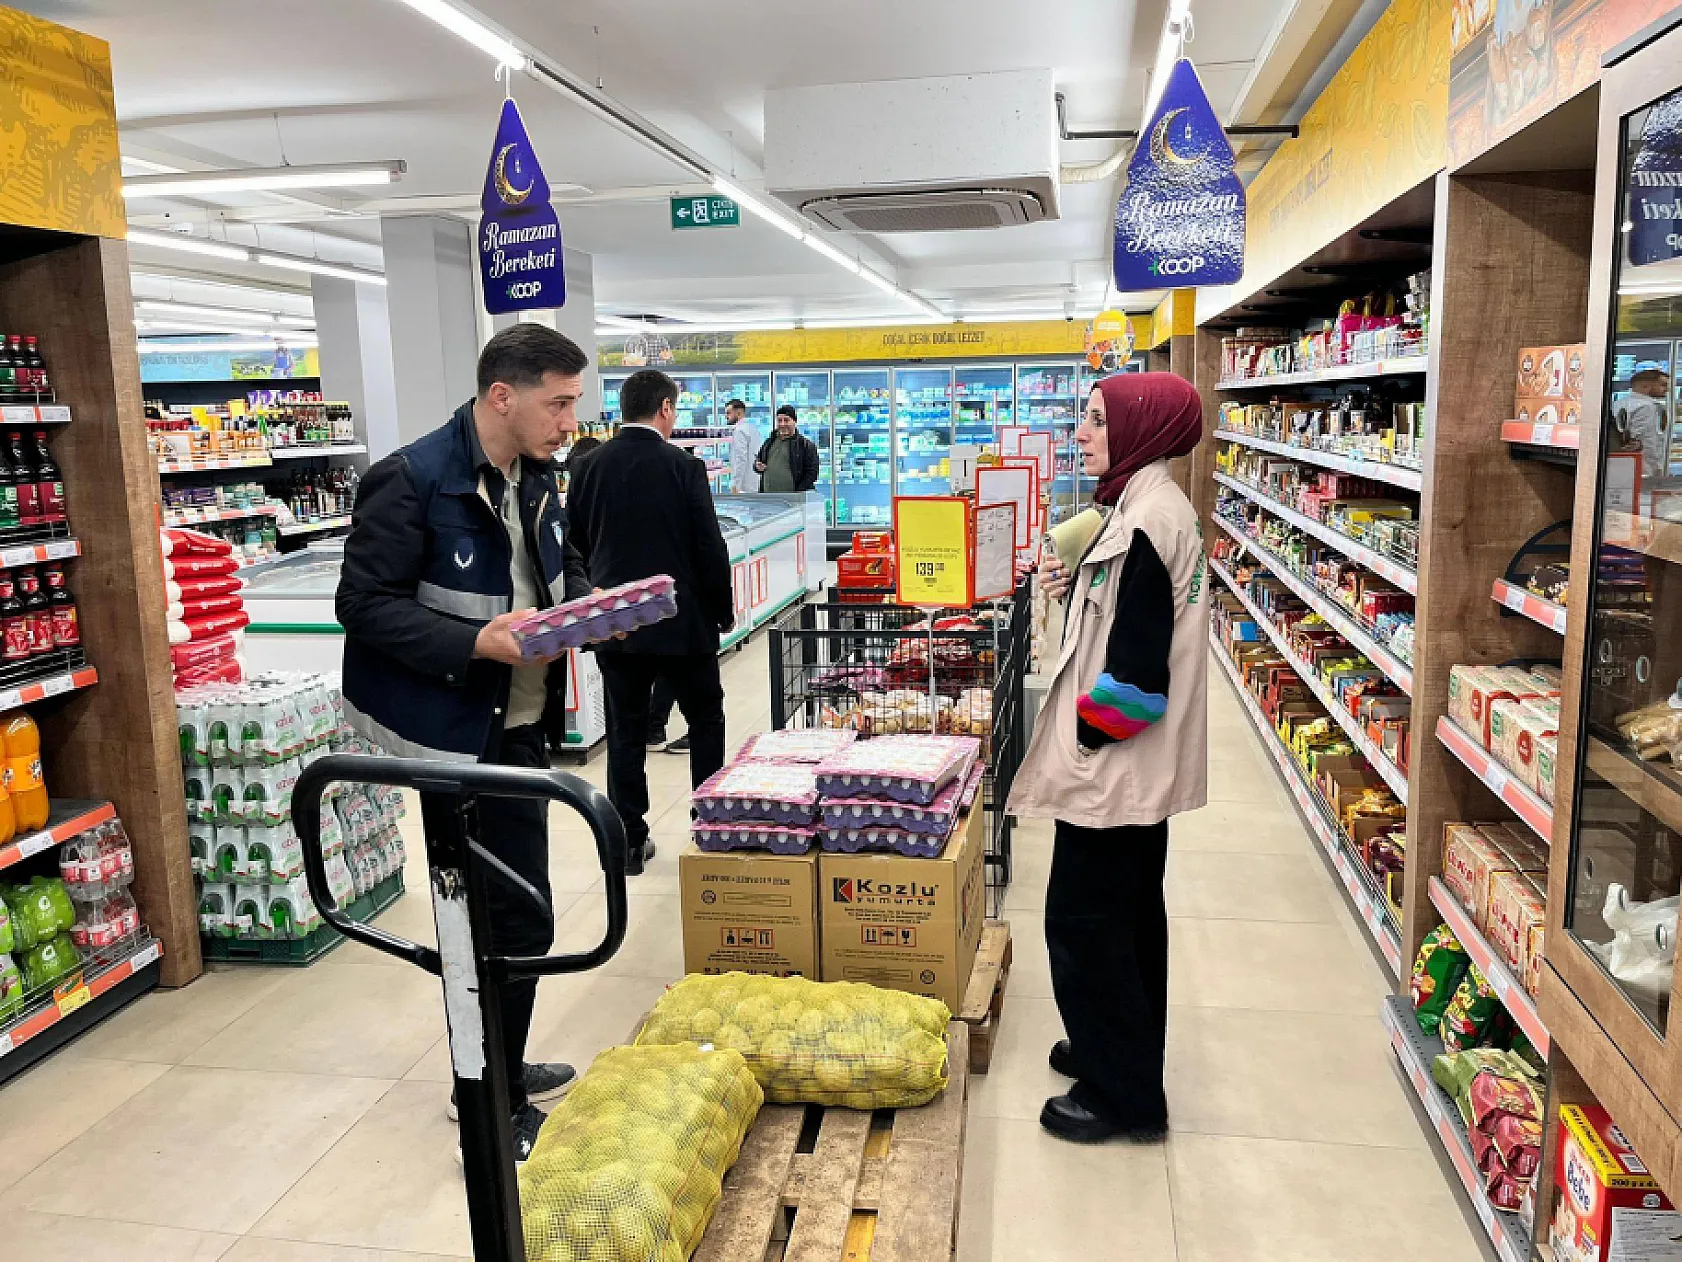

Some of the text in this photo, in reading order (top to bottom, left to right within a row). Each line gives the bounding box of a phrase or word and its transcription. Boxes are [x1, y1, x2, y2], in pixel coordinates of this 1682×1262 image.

[712, 209, 734, 219] EXIT
[1122, 191, 1238, 221] Ramazan
[484, 222, 556, 252] Ramazan
[489, 248, 556, 278] Bereketi
[915, 562, 934, 577] 139
[857, 878, 935, 897] Kozlu
[857, 897, 936, 906] yumurta
